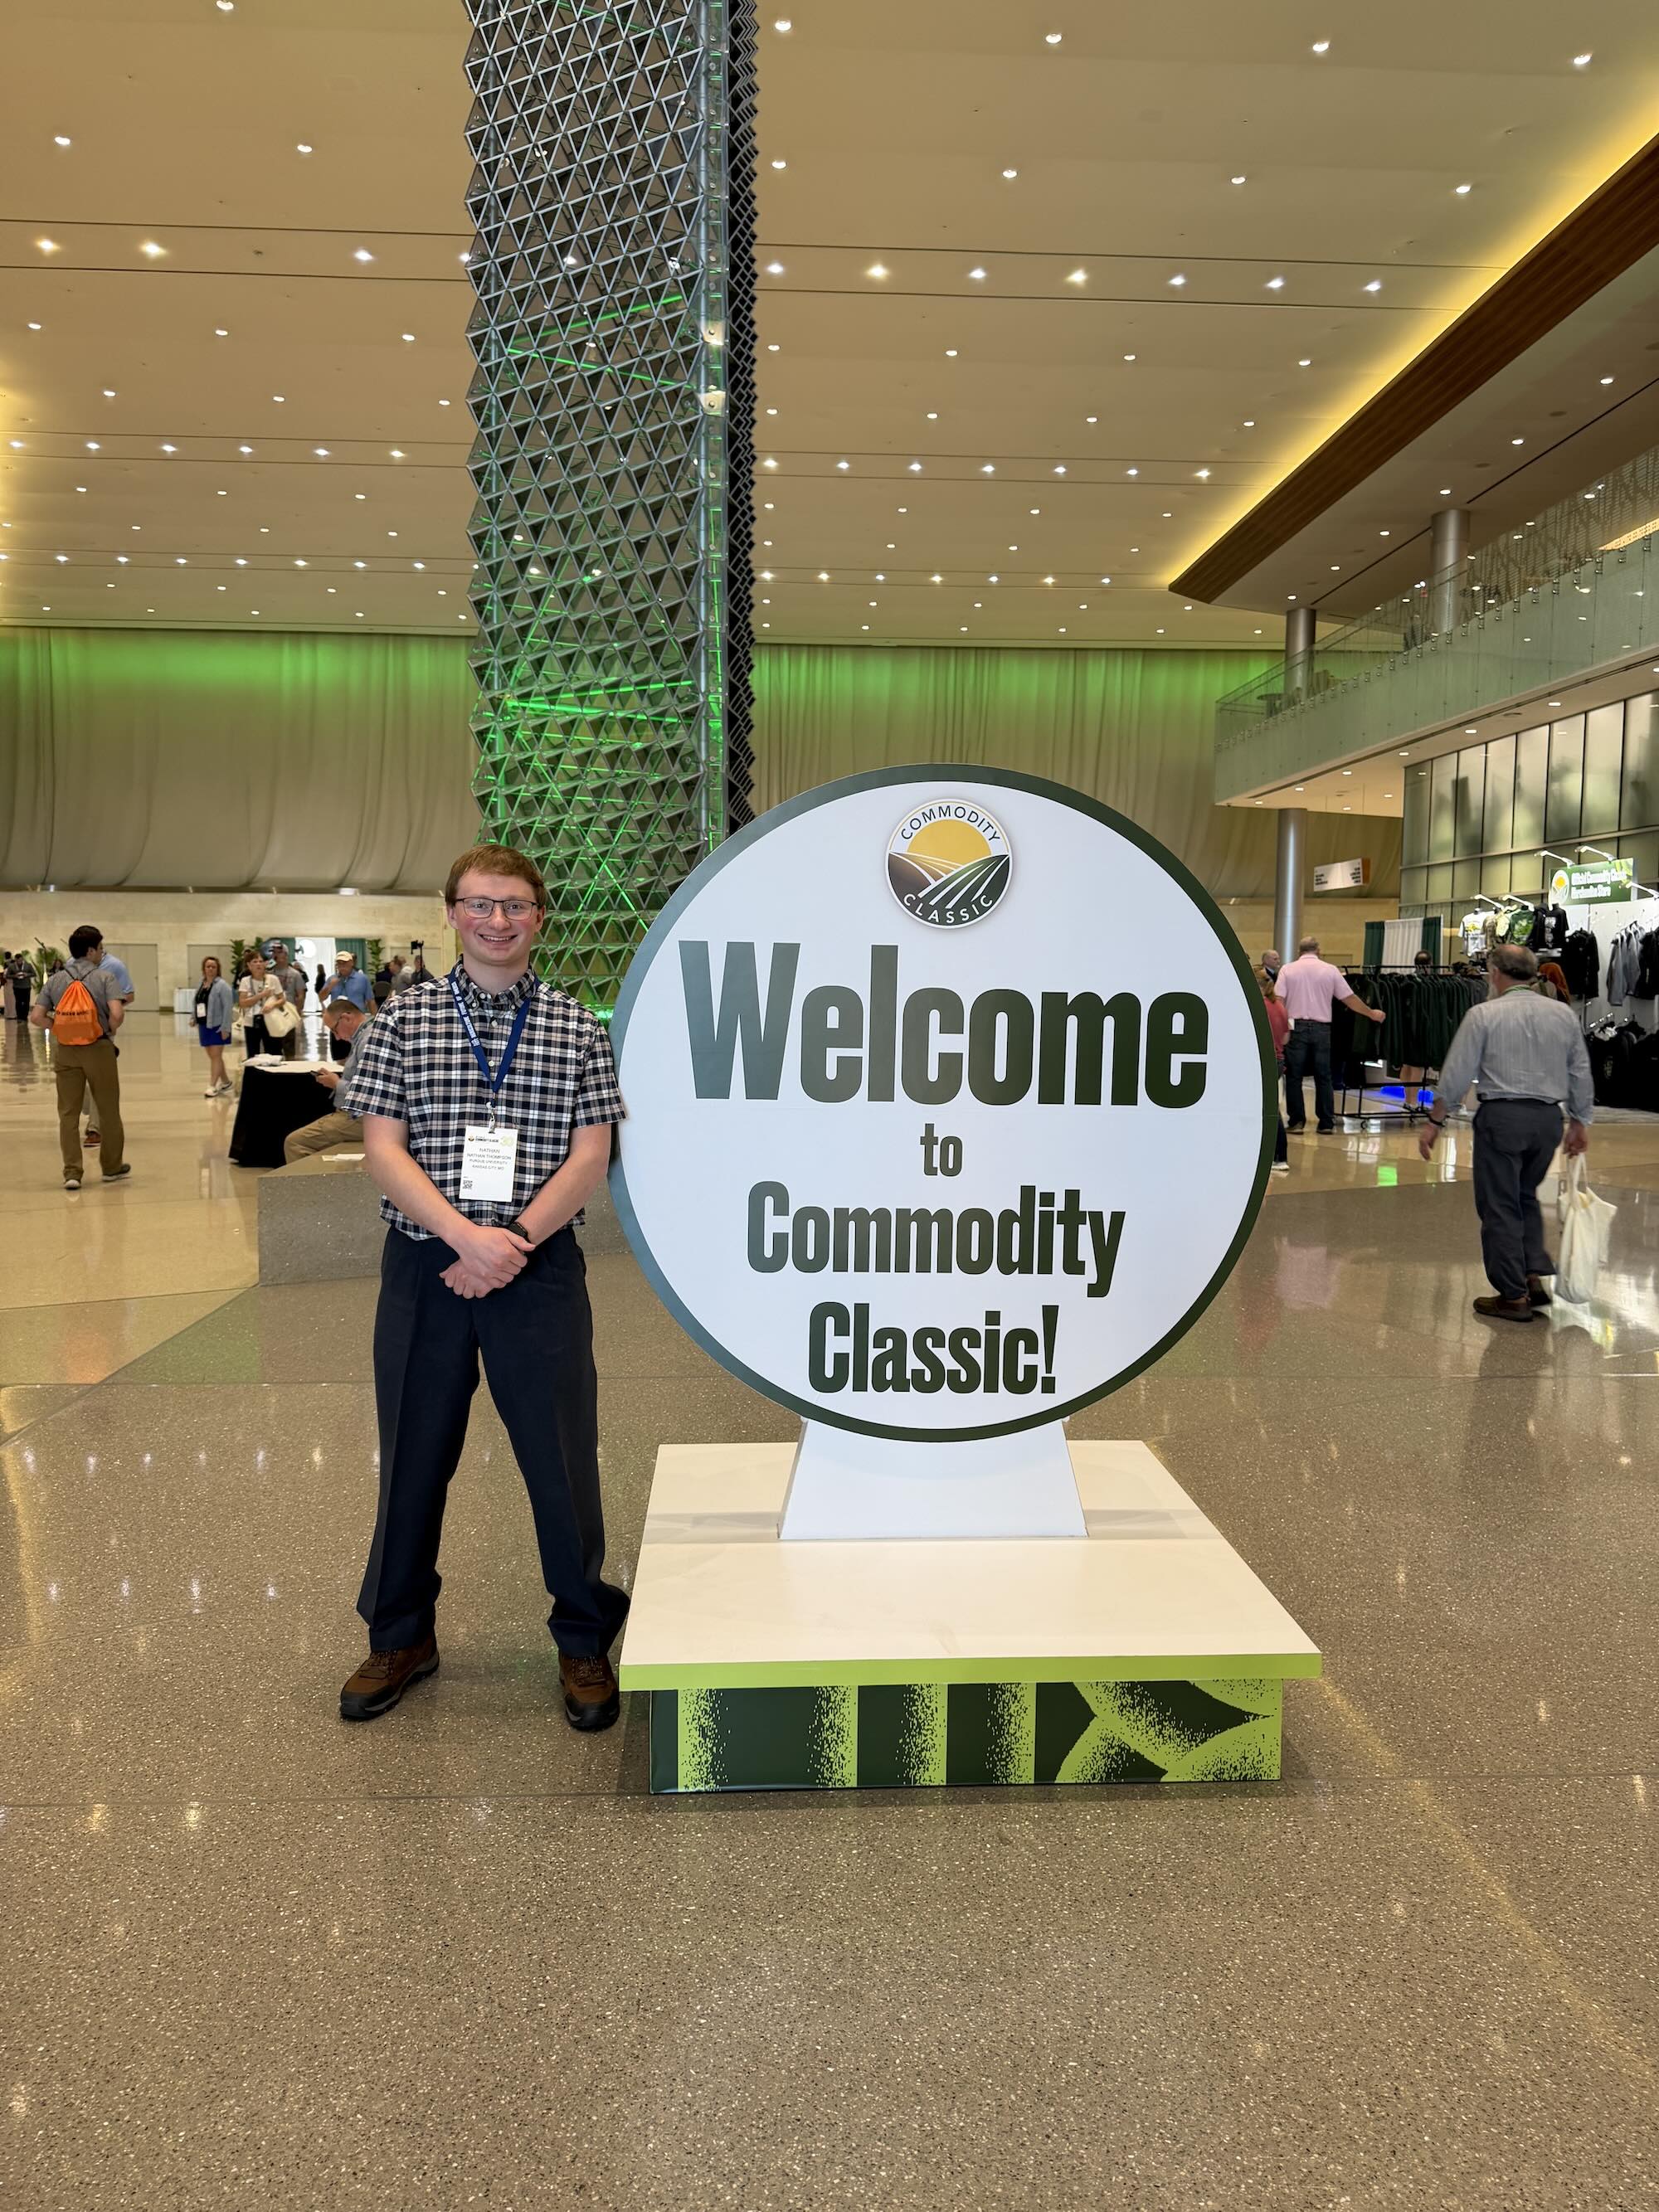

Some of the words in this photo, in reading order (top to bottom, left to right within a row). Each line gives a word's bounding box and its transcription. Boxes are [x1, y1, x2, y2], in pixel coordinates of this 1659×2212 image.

[901, 805, 1000, 841] COMMODITY
[903, 893, 993, 923] CLASSIC
[679, 941, 1209, 1108] Welcome
[920, 1122, 963, 1177] to
[747, 1181, 1126, 1298] Commodity
[808, 1301, 1059, 1394] Classic!
